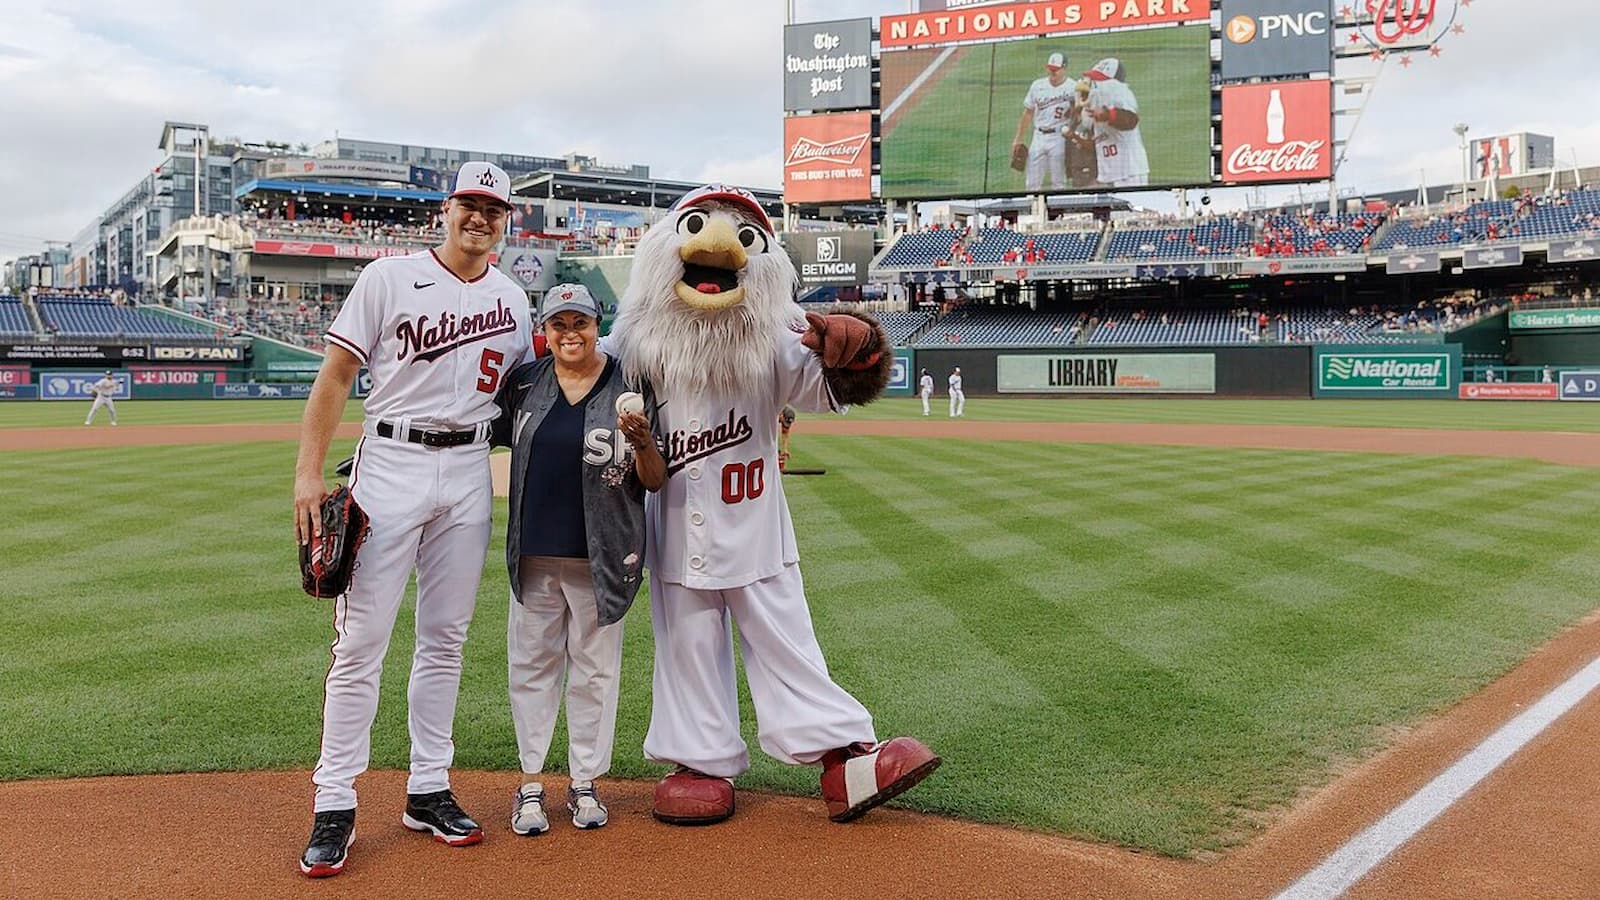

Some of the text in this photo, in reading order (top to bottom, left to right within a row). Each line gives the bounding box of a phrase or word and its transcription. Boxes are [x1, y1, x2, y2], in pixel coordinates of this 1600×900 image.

[891, 0, 1191, 39] NATIONALS PARK
[1259, 11, 1326, 39] PNC
[813, 32, 841, 51] The
[786, 52, 868, 74] Washington
[810, 75, 843, 98] Post
[792, 143, 860, 159] Budweiser
[1227, 140, 1325, 175] Coca-Cola
[790, 171, 807, 181] THIS
[807, 170, 830, 180] BUD'S
[831, 169, 846, 179] FOR
[335, 244, 355, 257] THIS
[801, 262, 857, 276] BETMGM
[1072, 268, 1108, 276] CONGRESS
[1109, 267, 1129, 275] NIGHT
[1287, 263, 1319, 271] LIBRARY
[1527, 314, 1565, 325] Harris
[396, 298, 517, 362] Nationals
[199, 346, 238, 359] FAN
[477, 348, 505, 394] 5
[1048, 358, 1118, 386] LIBRARY
[1352, 359, 1442, 378] National
[224, 384, 249, 393] MGM
[1381, 378, 1437, 387] Car Rental
[1585, 379, 1597, 393] D
[664, 407, 753, 466] tionals
[721, 457, 764, 505] 00
